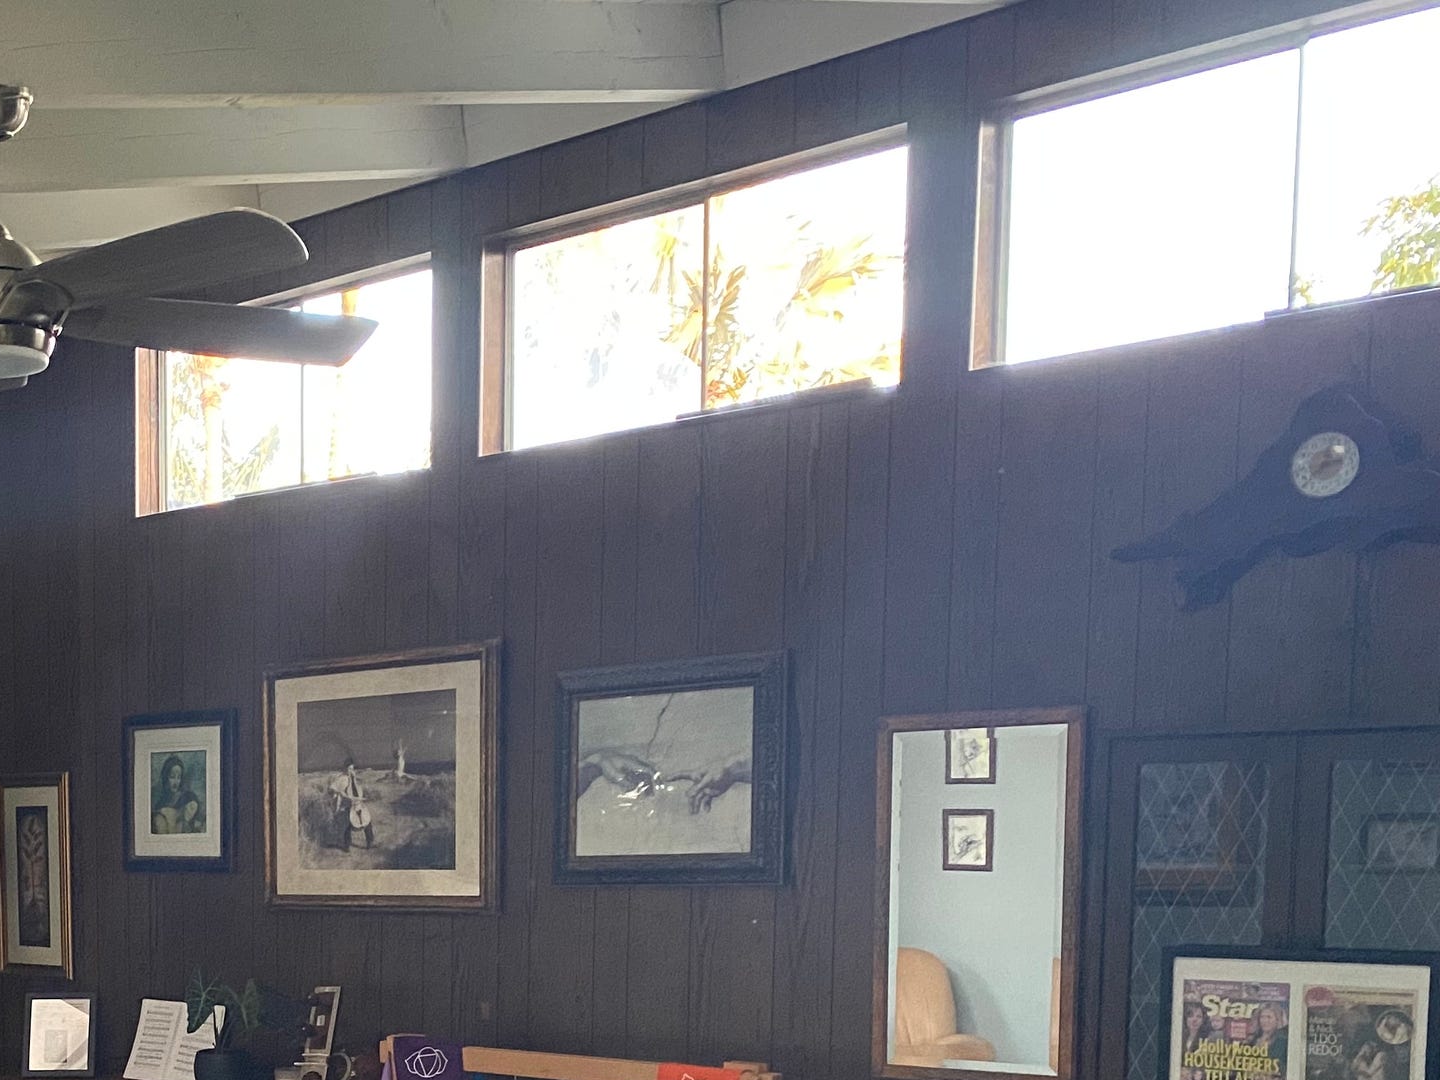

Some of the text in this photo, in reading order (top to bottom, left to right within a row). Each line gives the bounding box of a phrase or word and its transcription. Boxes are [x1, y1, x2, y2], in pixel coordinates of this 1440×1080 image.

[1202, 994, 1259, 1019] Star
[1309, 1044, 1342, 1056] REDO!
[1184, 1052, 1279, 1073] HOUSEKEEPERS
